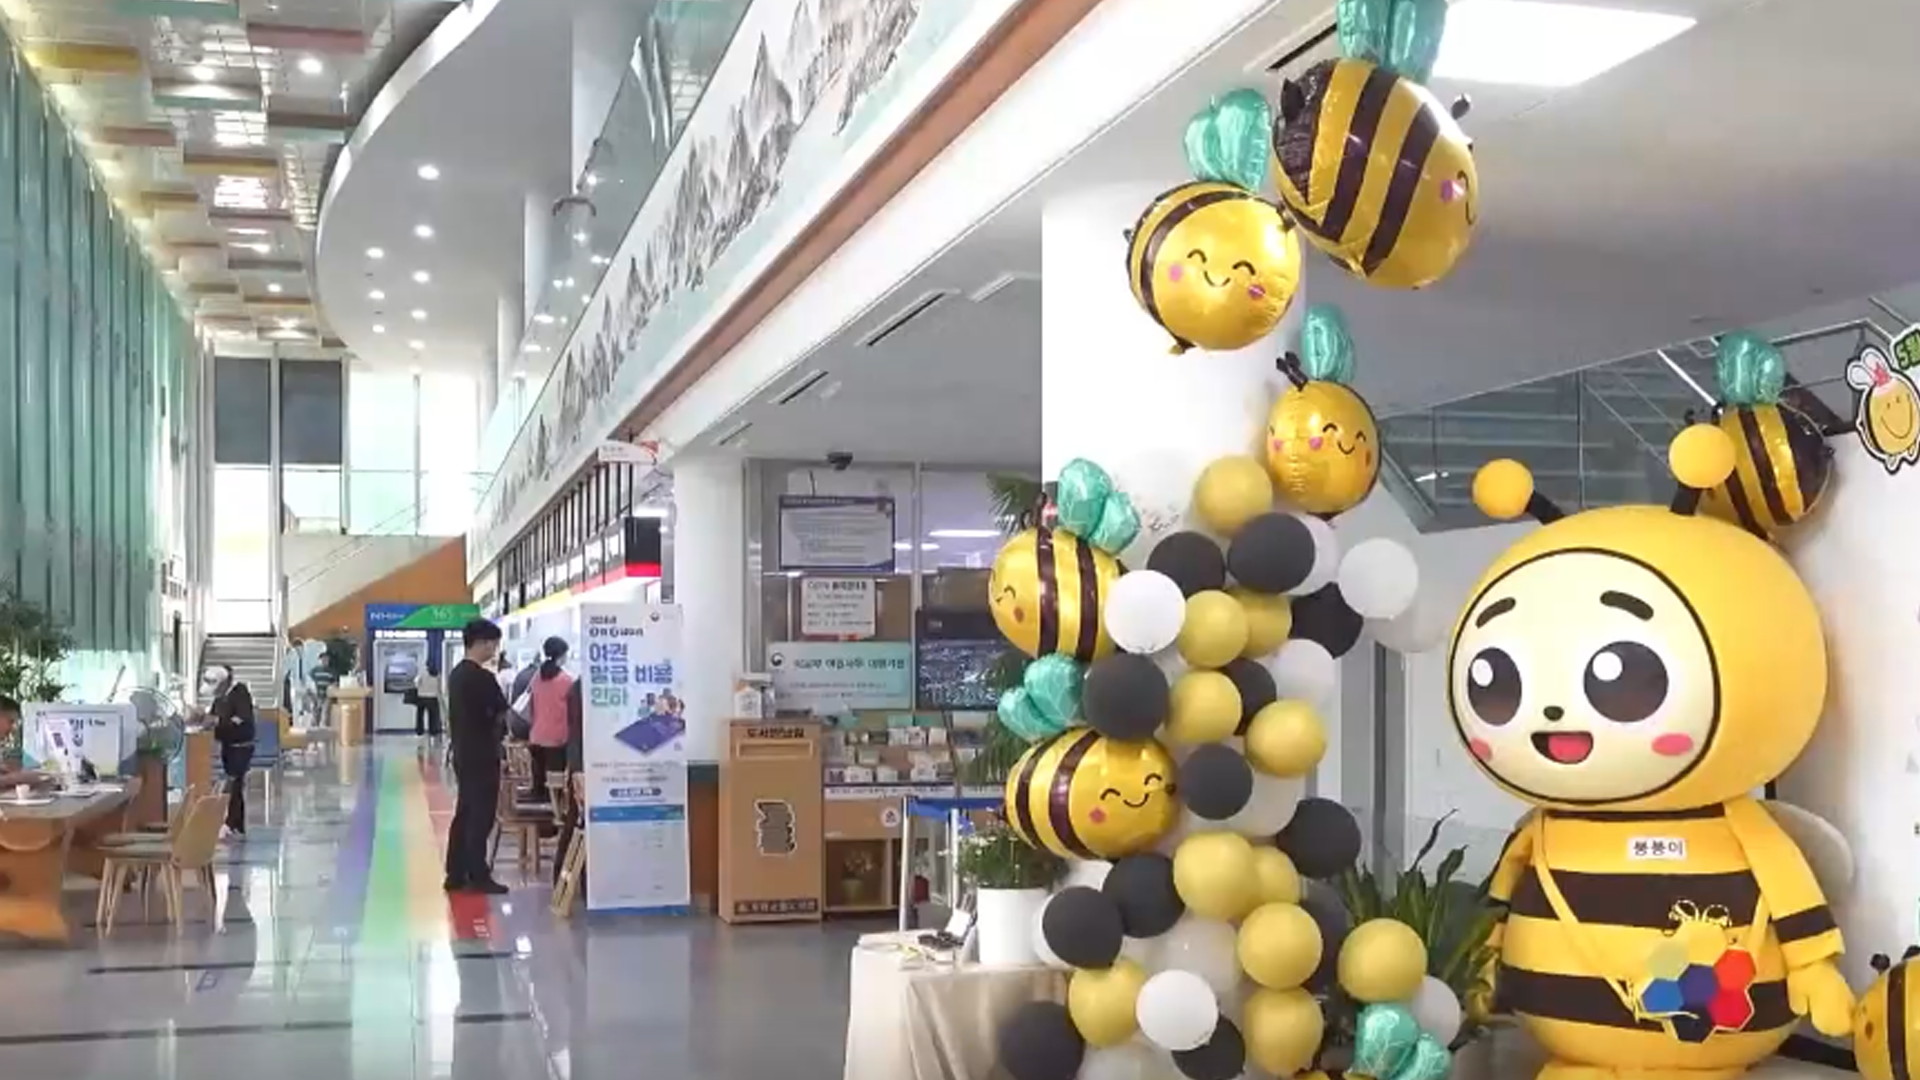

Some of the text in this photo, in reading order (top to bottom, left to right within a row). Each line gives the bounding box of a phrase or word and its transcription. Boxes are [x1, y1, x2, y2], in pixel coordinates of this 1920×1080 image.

[589, 643, 628, 662] 여권
[590, 664, 673, 684] 발급 비용
[591, 687, 628, 707] 인하
[1633, 840, 1683, 856] 붕붕이
